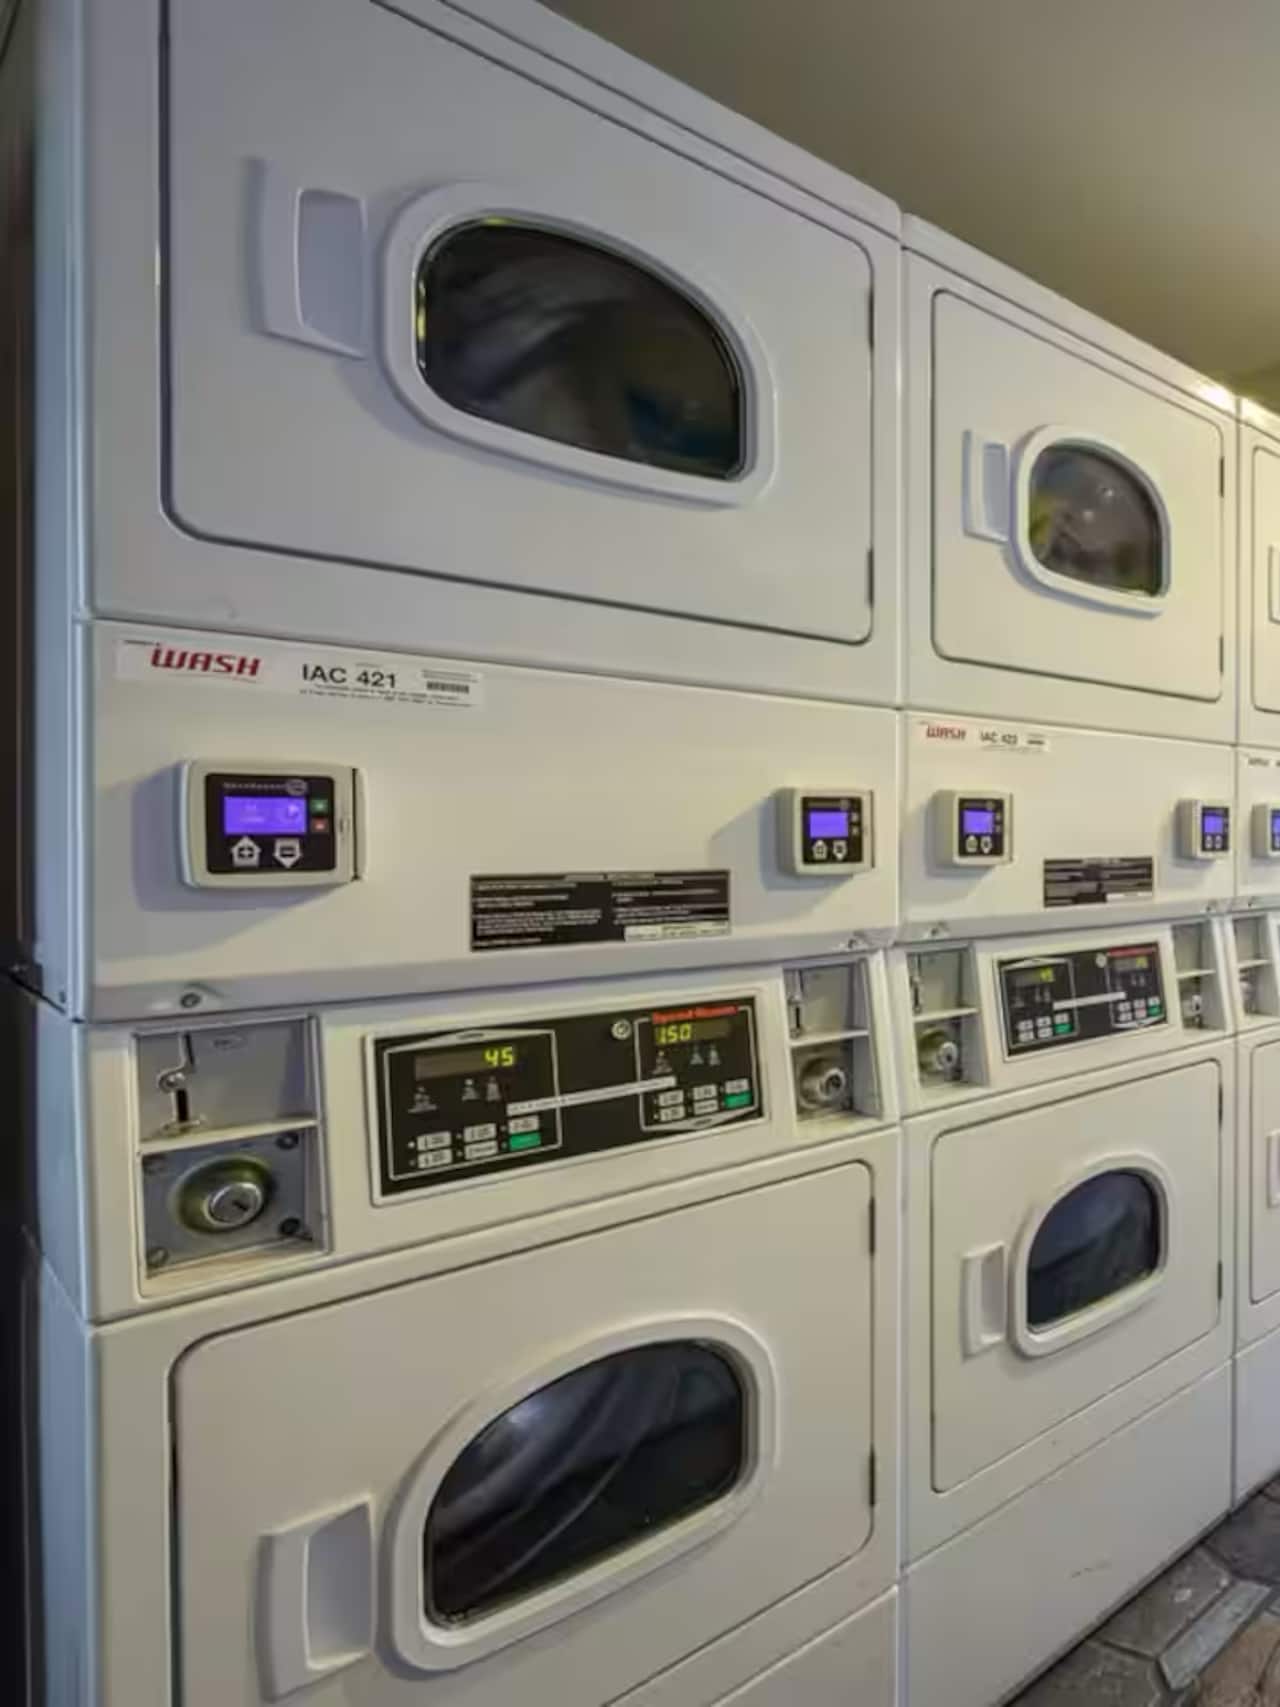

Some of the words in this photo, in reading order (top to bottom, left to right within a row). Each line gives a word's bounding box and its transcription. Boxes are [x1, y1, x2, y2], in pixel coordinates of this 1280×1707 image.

[302, 663, 347, 684] IAC
[356, 670, 397, 689] 421
[658, 1023, 692, 1044] 150
[484, 1046, 514, 1067] 45
